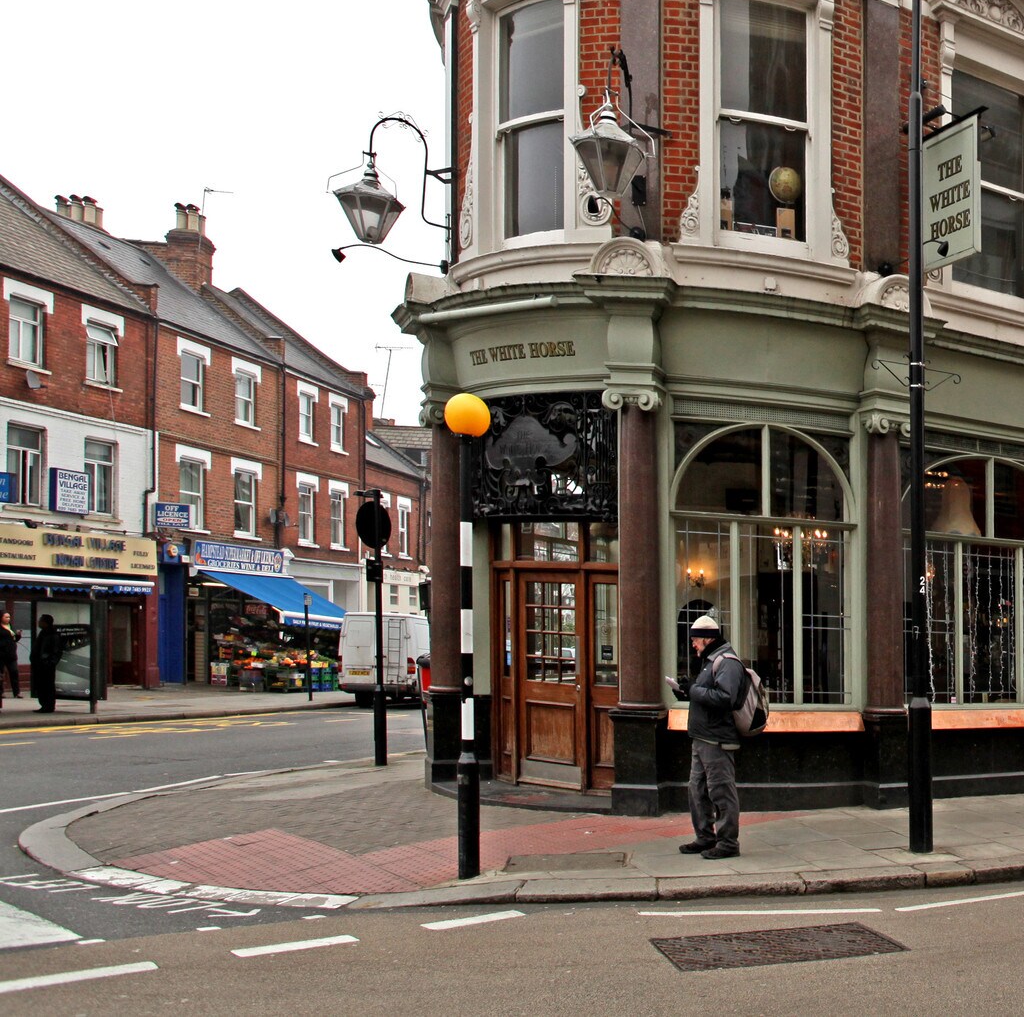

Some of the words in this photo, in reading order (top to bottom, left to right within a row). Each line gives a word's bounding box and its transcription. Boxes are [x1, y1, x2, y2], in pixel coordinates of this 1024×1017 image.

[937, 154, 963, 182] THE
[929, 179, 971, 213] WHITE
[930, 208, 971, 241] HORSE
[469, 348, 488, 366] THE
[488, 343, 526, 362] WHITE
[528, 340, 576, 359] HORSE
[58, 471, 87, 483] BENGAL
[59, 480, 88, 491] VILLAGE
[156, 510, 189, 519] LICENCE
[42, 532, 84, 548] BENGAL
[86, 536, 126, 552] VILLAGE
[0, 551, 37, 561] ESTAURANT
[207, 559, 240, 570] GROCERIES
[240, 562, 256, 571] WINE
[261, 565, 274, 573] DELI
